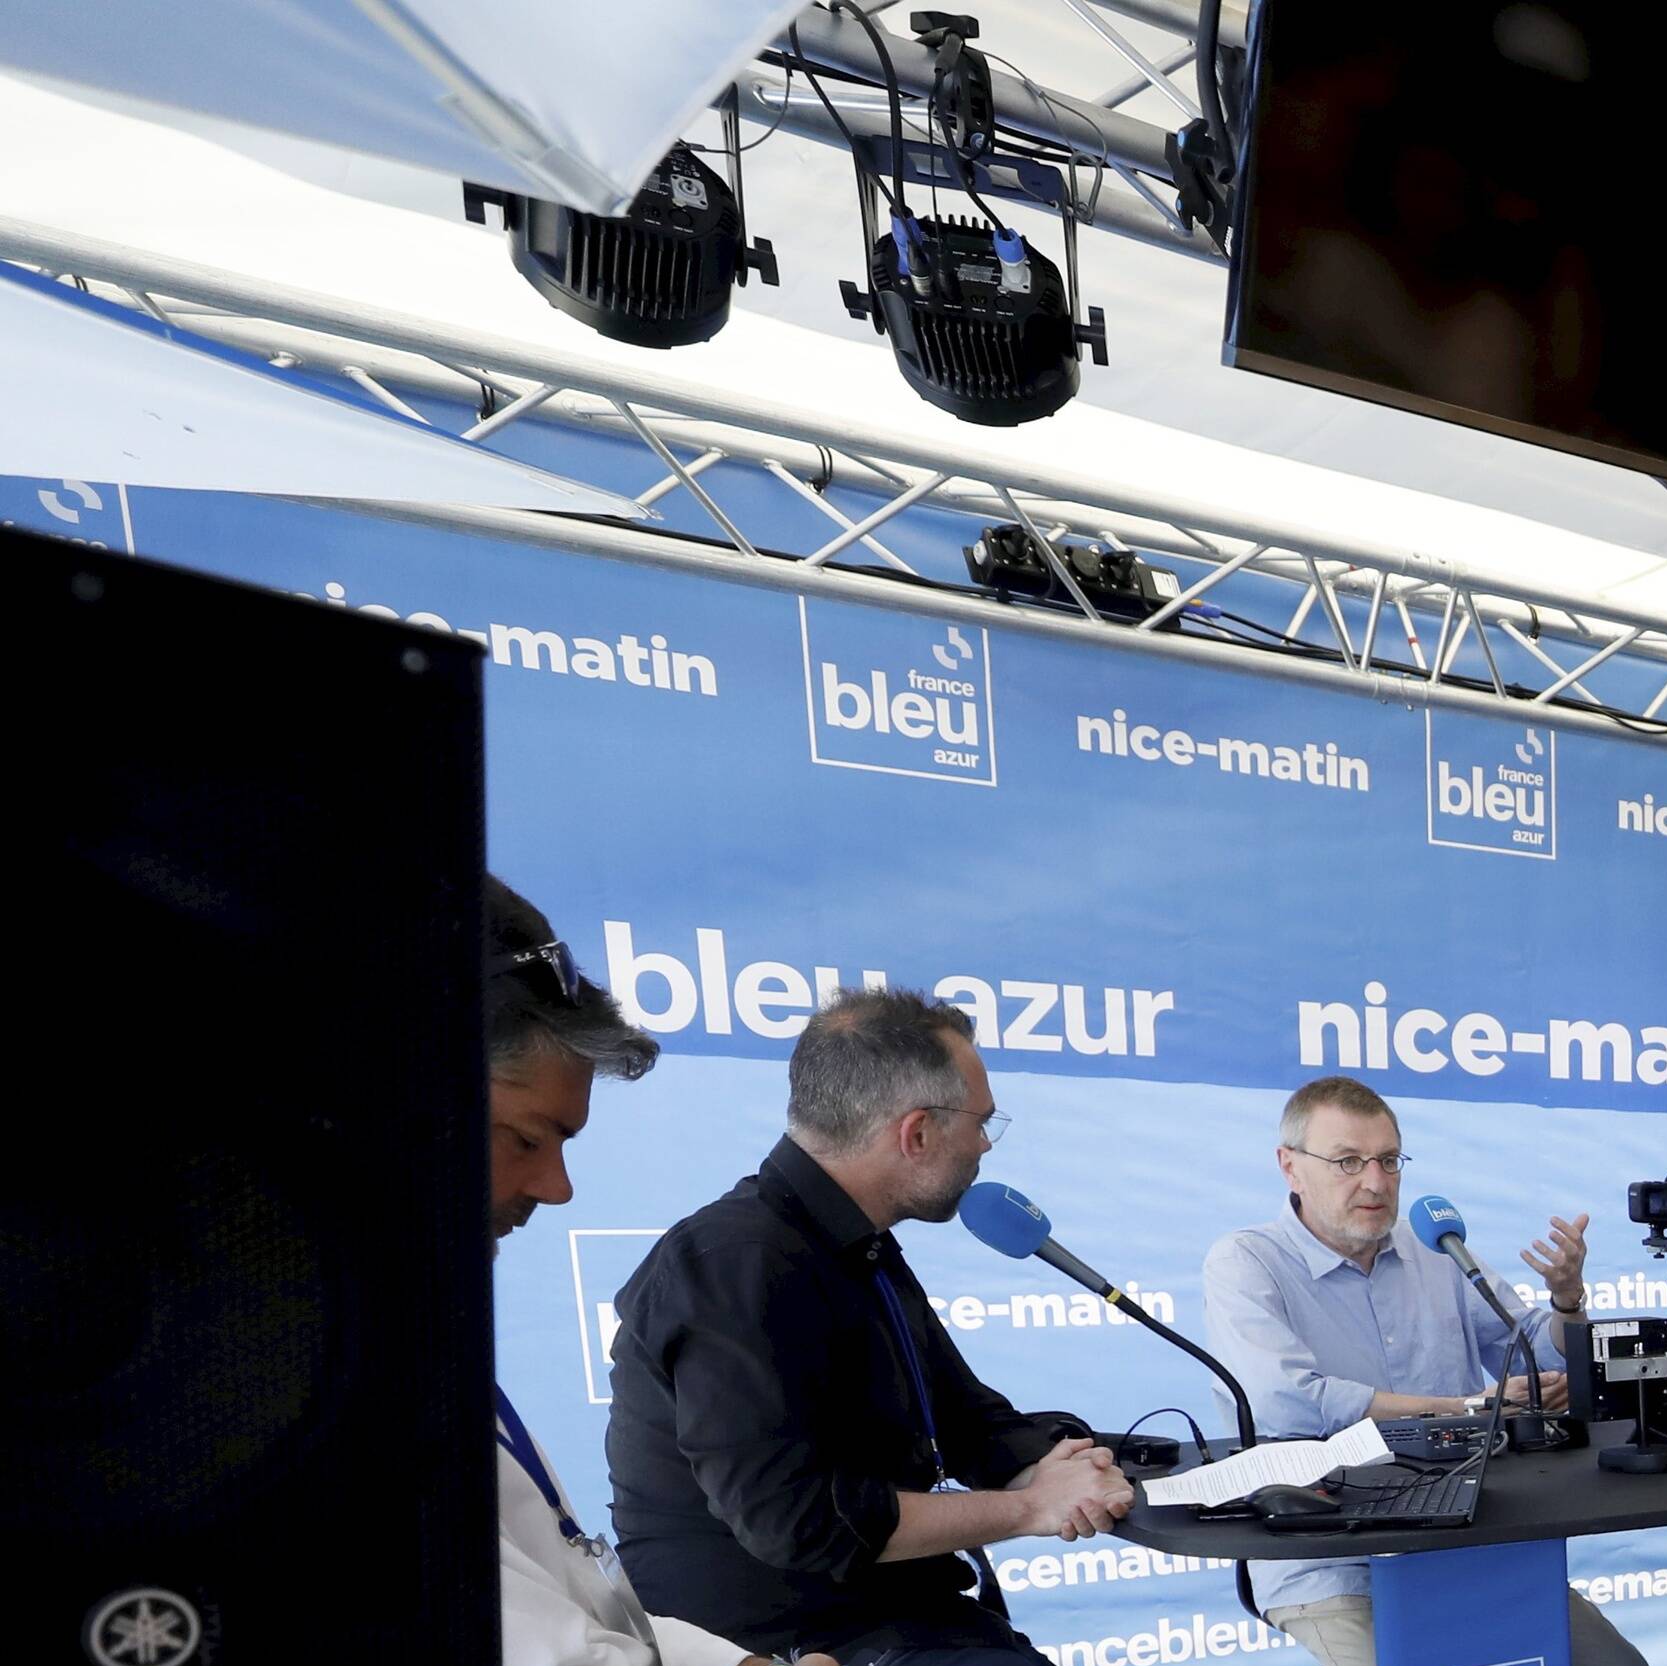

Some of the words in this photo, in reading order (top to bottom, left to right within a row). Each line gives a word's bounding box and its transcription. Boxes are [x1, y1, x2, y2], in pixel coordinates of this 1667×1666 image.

[822, 662, 979, 746] bleu
[907, 669, 975, 697] france
[933, 749, 979, 768] azur
[1077, 709, 1369, 792] nice-matin
[1438, 761, 1545, 827] bleu
[1498, 765, 1544, 786] france
[1512, 828, 1545, 845] azur
[933, 975, 1174, 1057] azur
